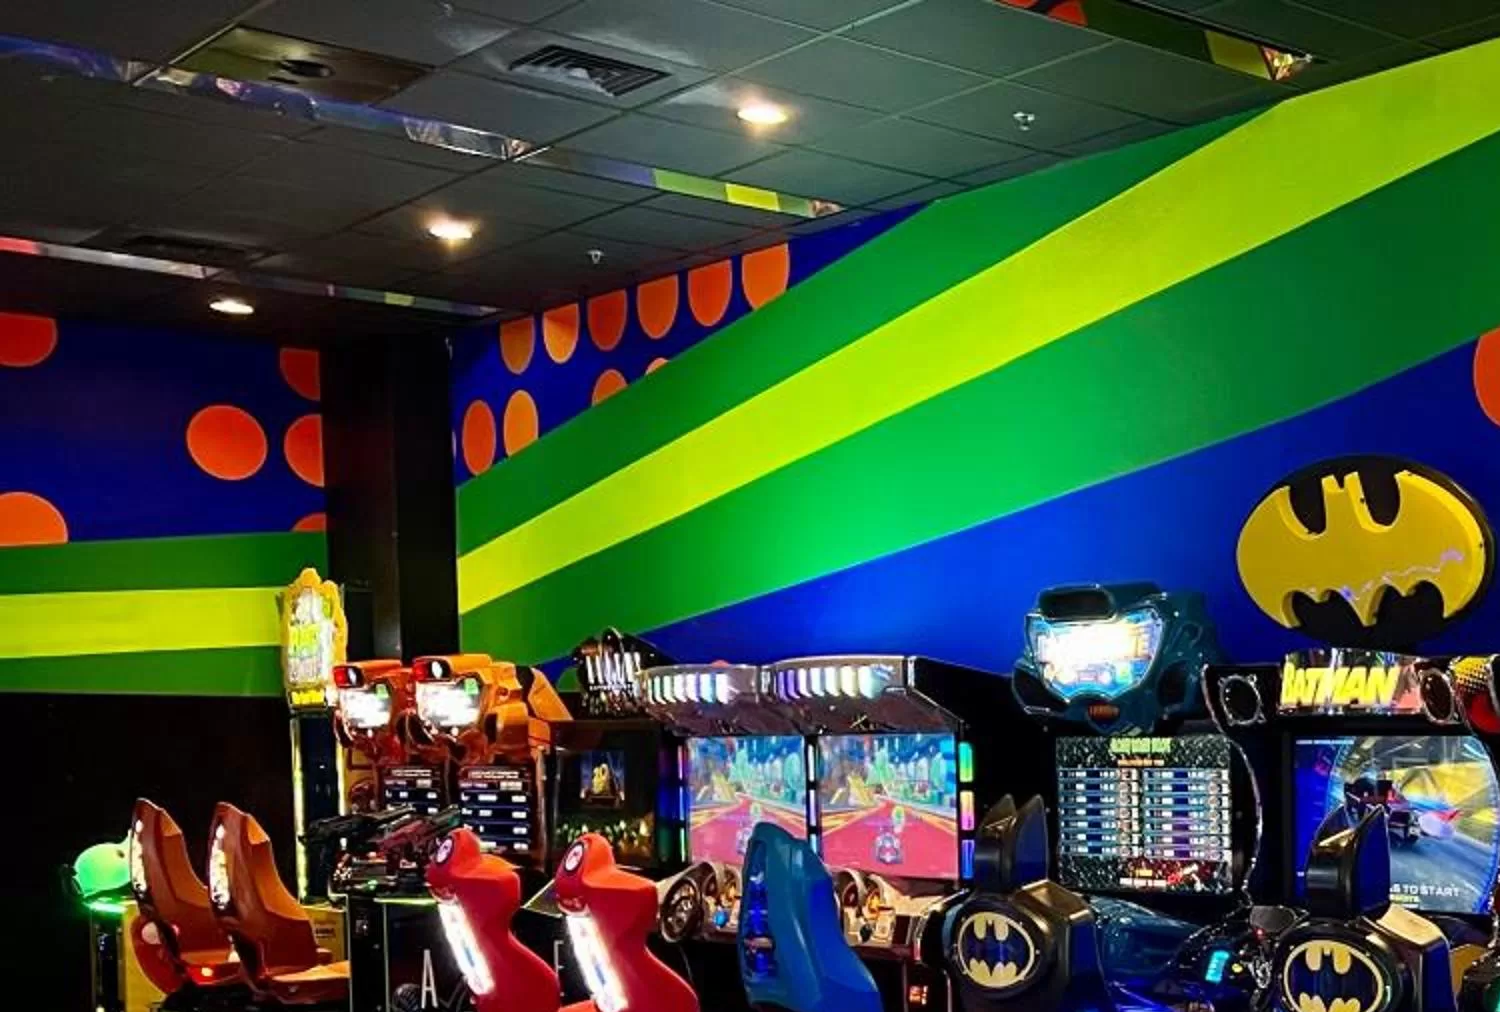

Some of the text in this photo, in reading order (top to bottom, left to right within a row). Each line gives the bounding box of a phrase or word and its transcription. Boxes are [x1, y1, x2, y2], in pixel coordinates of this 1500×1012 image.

[1281, 661, 1401, 705] BATMAN
[1402, 884, 1418, 895] TO
[1420, 884, 1460, 897] START
